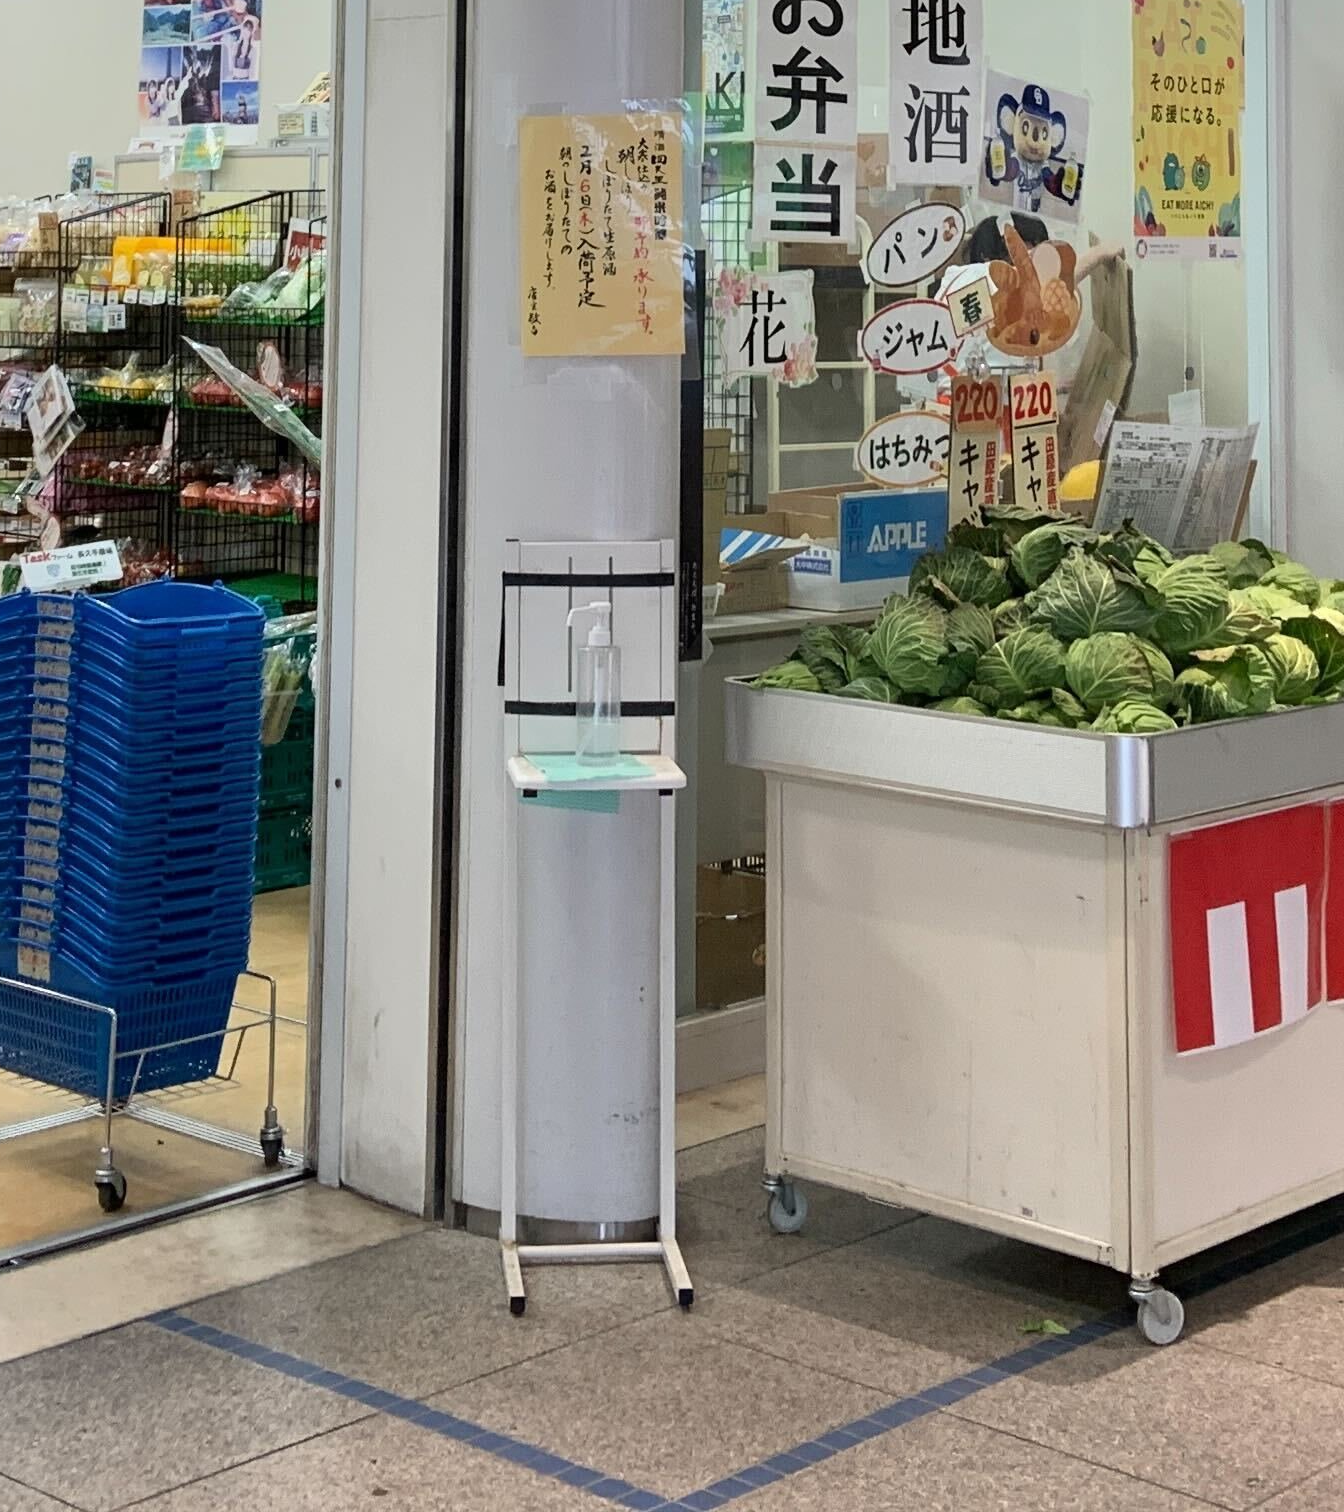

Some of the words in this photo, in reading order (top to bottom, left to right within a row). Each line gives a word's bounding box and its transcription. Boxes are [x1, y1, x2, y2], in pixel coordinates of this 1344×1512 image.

[1150, 73, 1226, 96] そのひと口が
[1150, 103, 1222, 127] 応援になる。
[1161, 198, 1174, 210] EAT
[882, 225, 940, 276] パン
[959, 291, 983, 328] 春
[739, 290, 788, 367] 花
[880, 320, 949, 360] ジャム
[1020, 435, 1043, 511] キャ
[866, 520, 927, 554] APPLE
